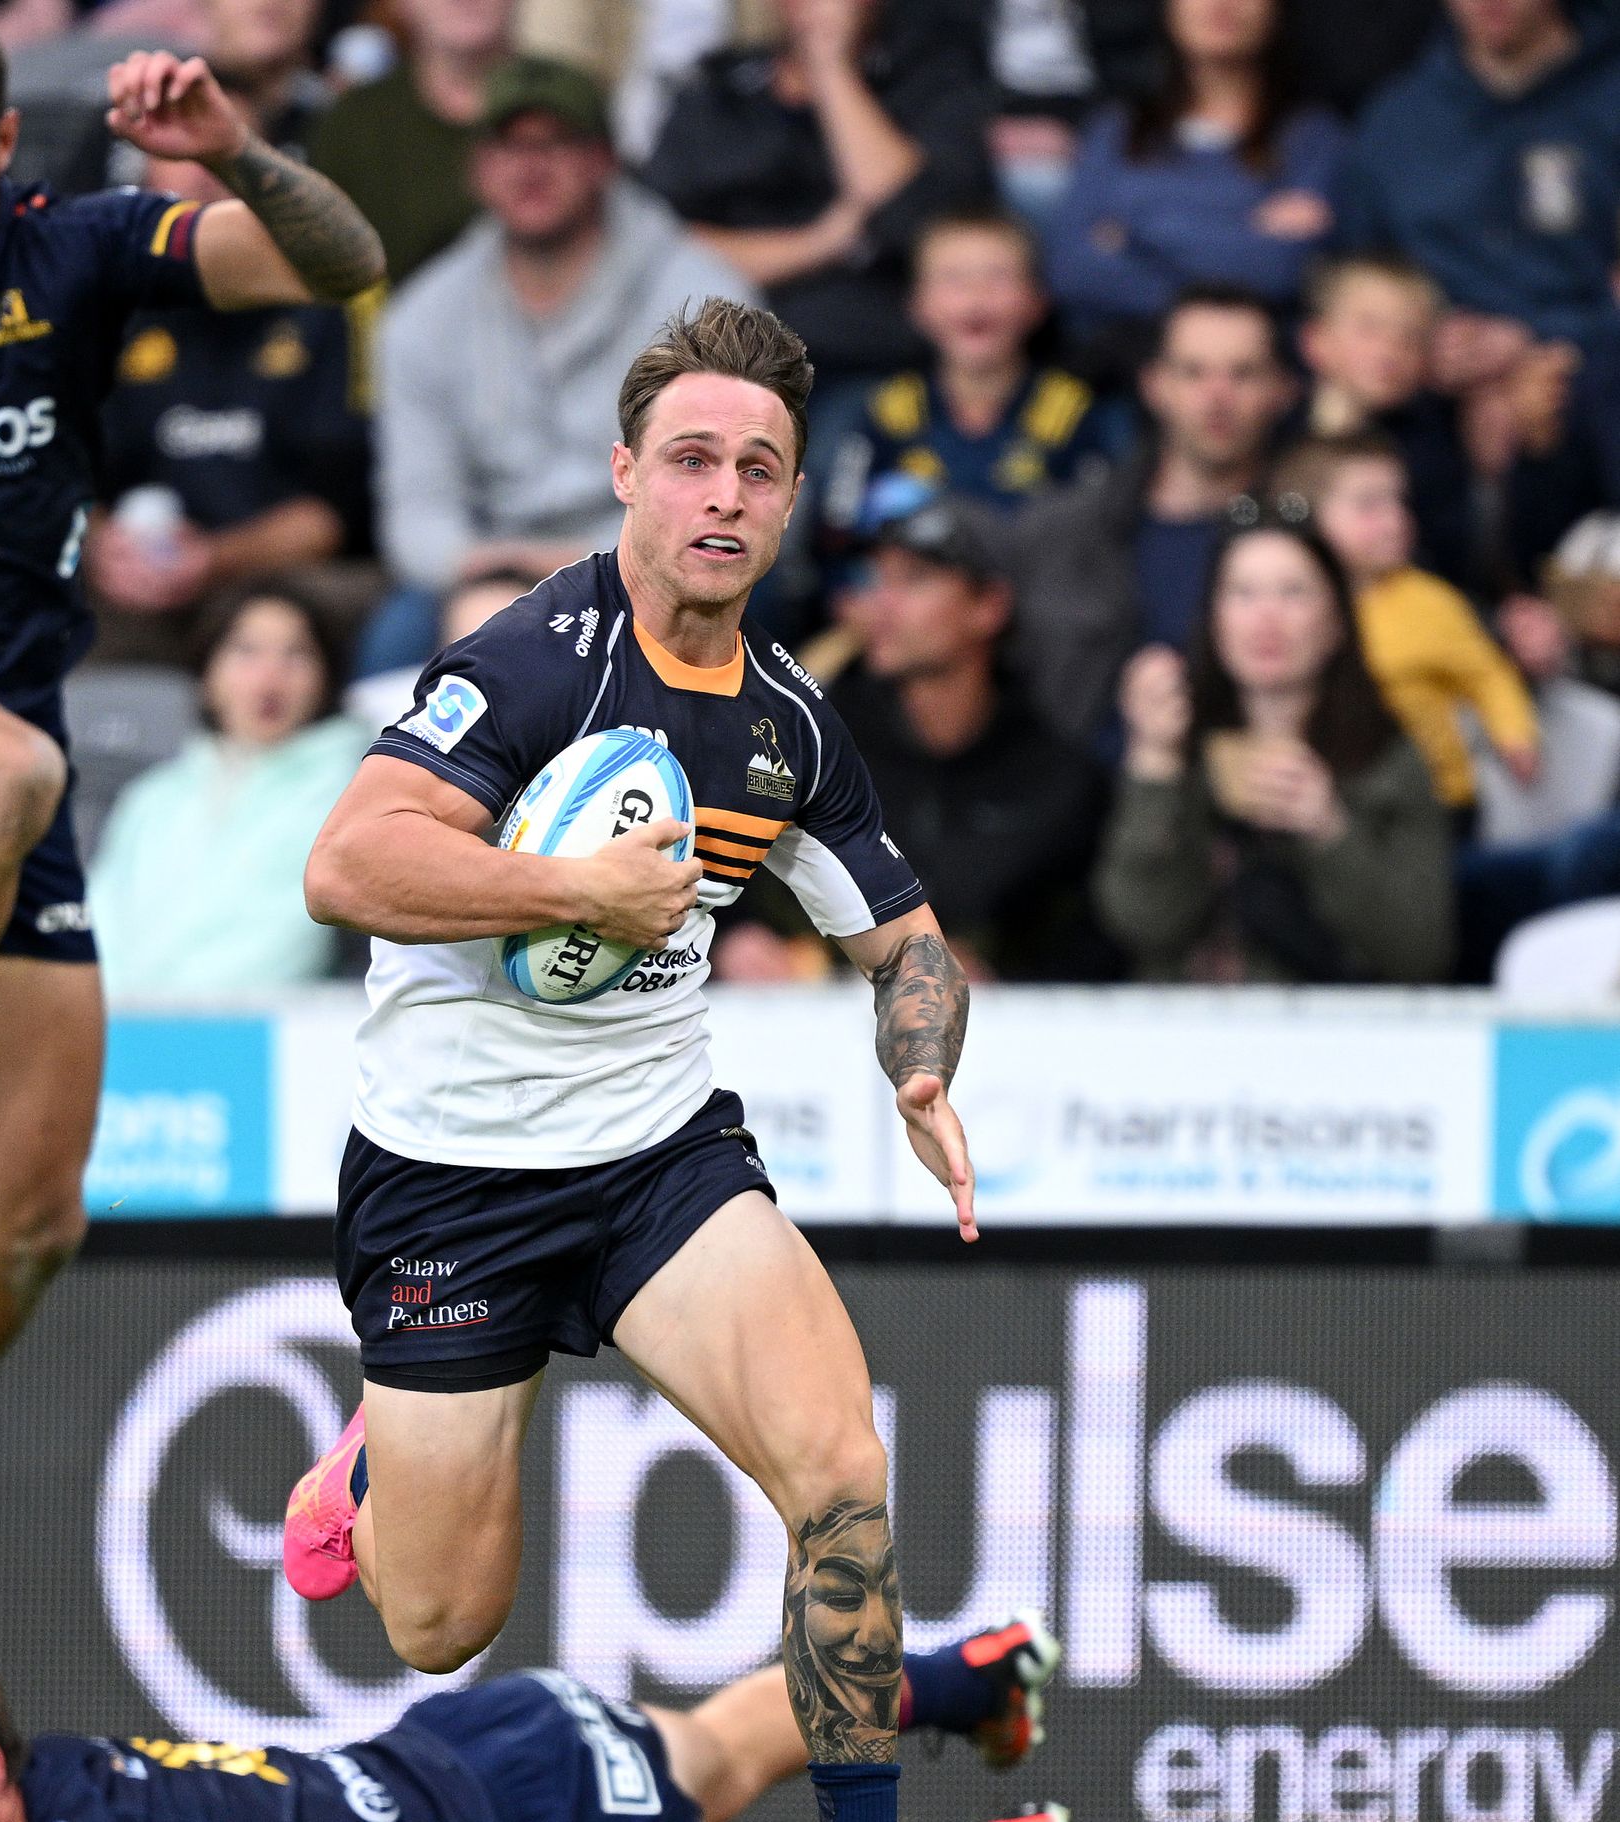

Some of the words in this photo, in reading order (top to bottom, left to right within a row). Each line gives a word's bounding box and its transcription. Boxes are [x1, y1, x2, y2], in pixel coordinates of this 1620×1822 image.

[1062, 1090, 1436, 1151] harrisons
[390, 1256, 459, 1277] Shaw
[386, 1299, 489, 1330] Partners
[391, 1280, 432, 1304] and
[553, 1278, 1618, 1708] pulse
[1134, 1722, 1618, 1822] energy
